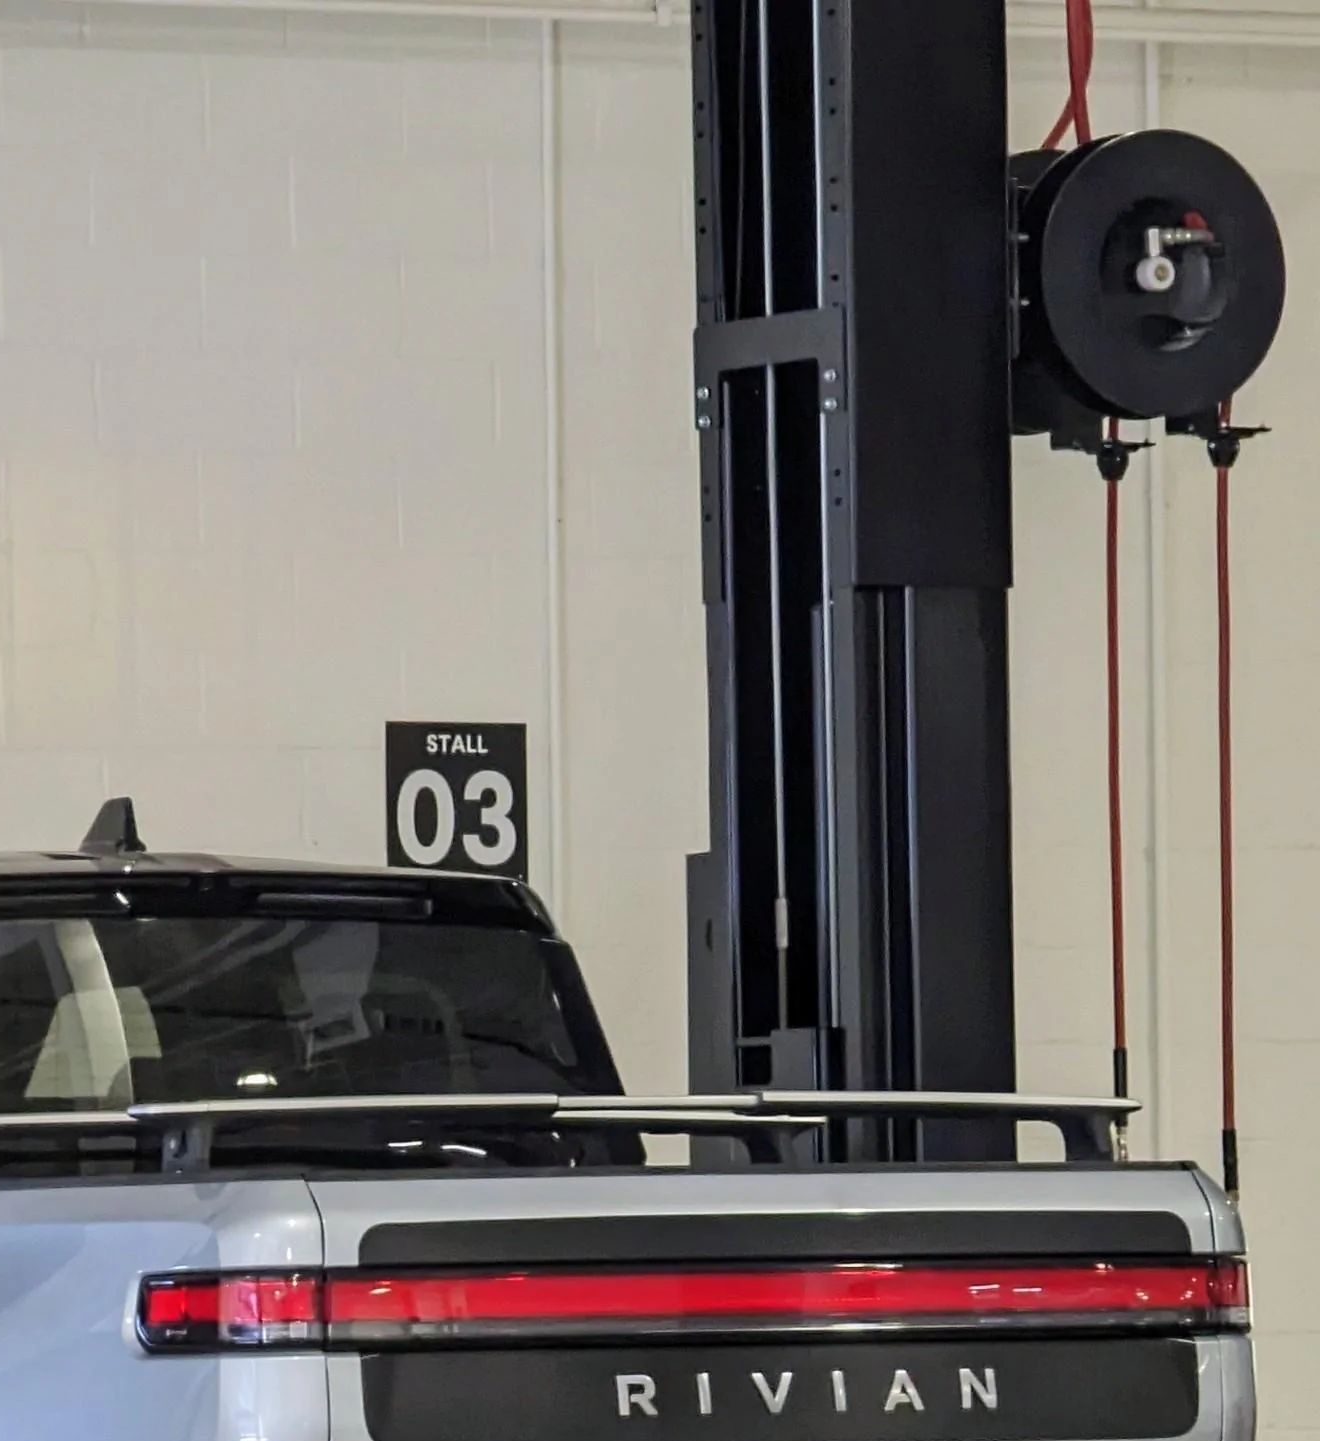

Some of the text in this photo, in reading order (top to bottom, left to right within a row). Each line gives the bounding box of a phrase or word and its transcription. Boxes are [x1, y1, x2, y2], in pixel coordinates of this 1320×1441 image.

[426, 733, 489, 755] STALL
[396, 768, 517, 866] 03
[614, 1366, 999, 1417] RIVIAN
